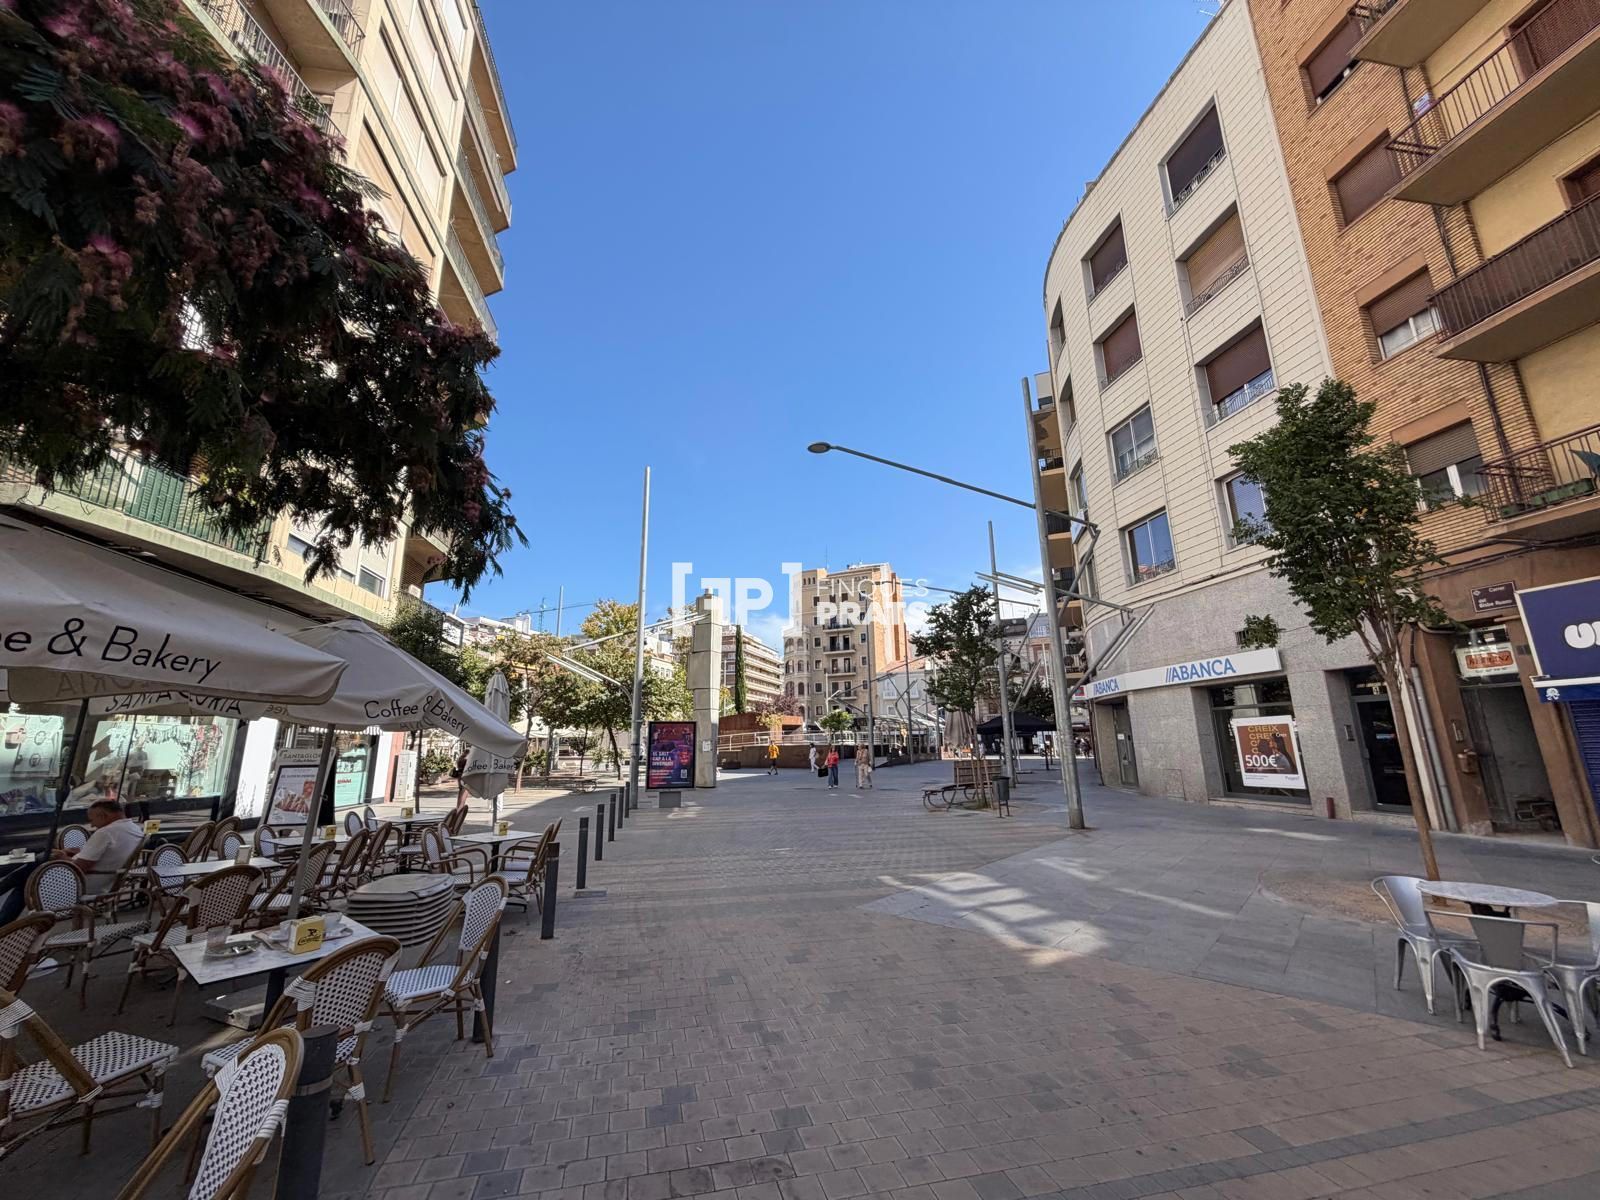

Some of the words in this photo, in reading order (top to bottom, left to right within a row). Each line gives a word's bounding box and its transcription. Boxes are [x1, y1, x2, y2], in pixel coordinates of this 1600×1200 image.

[47, 617, 88, 657] &
[101, 625, 222, 684] Bakery
[364, 699, 419, 719] Coffee
[430, 698, 470, 737] Bakery
